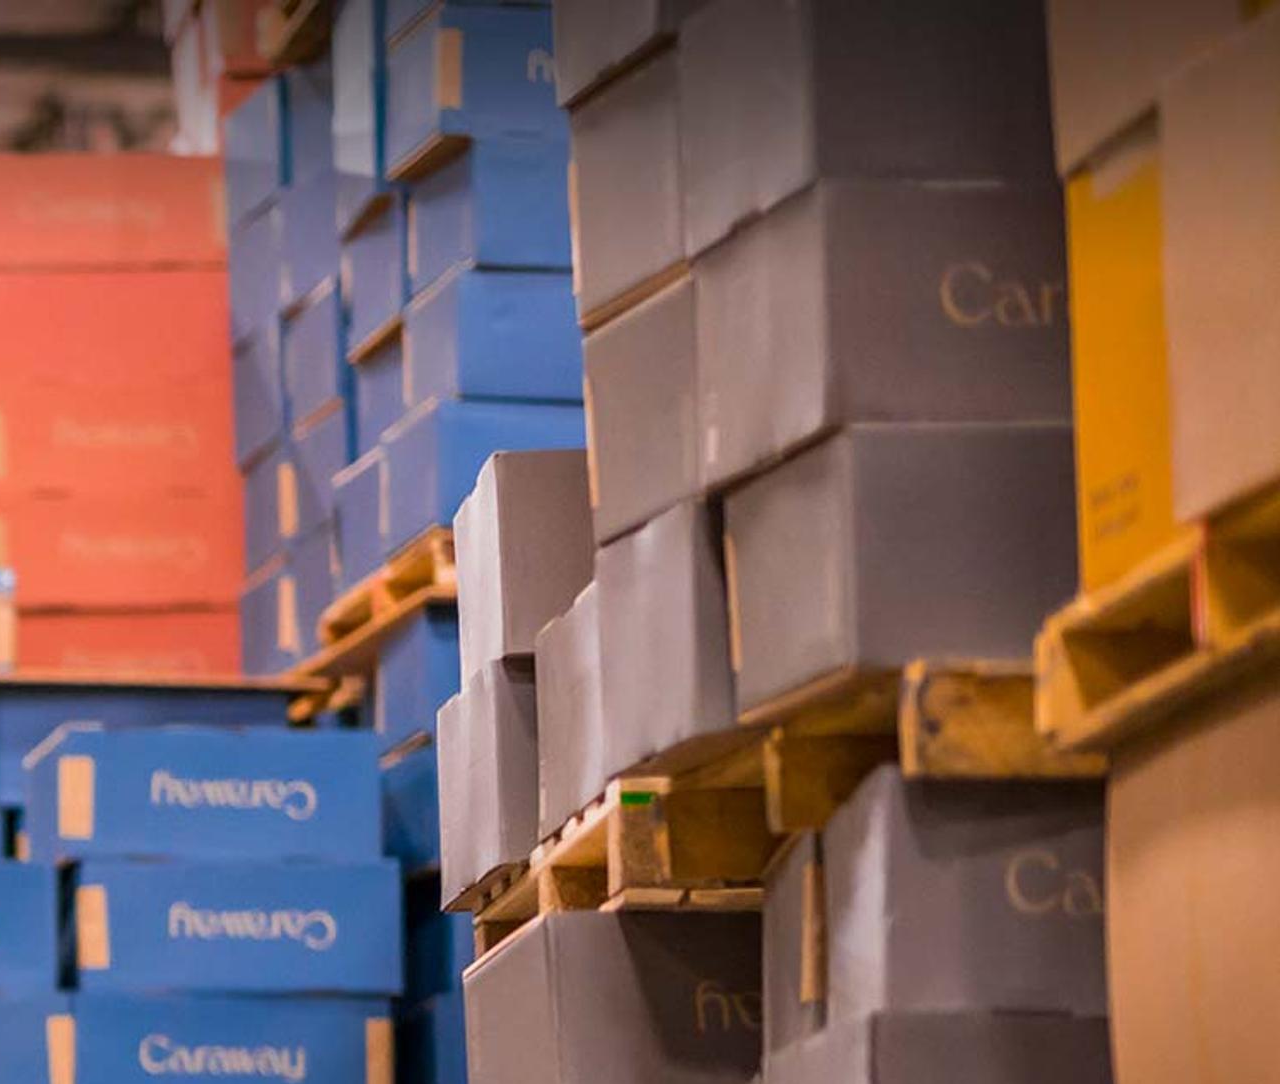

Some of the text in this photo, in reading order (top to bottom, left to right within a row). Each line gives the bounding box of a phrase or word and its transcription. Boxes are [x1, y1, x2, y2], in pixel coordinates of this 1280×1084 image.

[149, 769, 318, 822] Caraway
[167, 900, 339, 951] Caraway
[137, 1032, 308, 1084] Caraway
